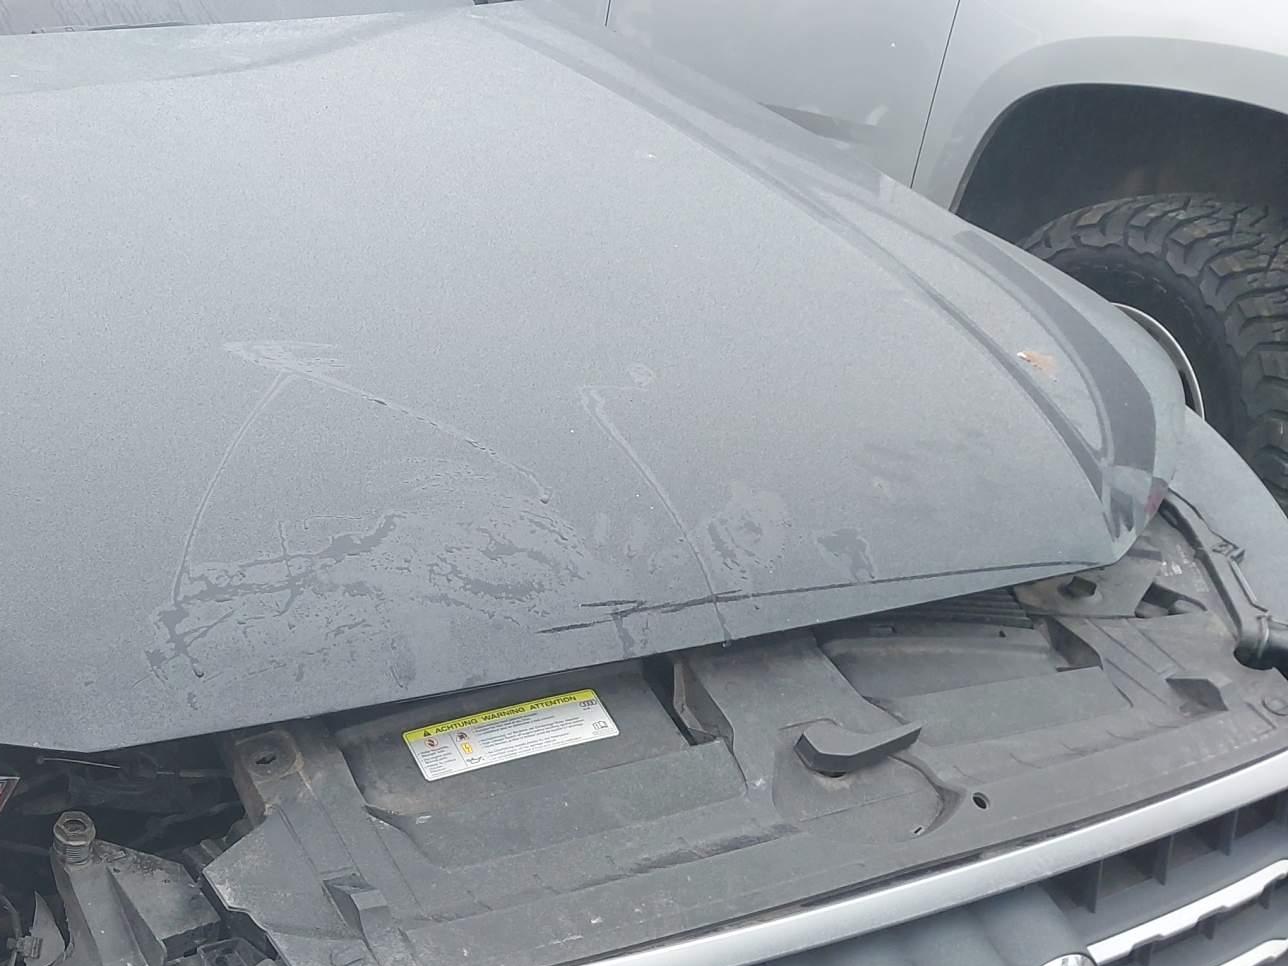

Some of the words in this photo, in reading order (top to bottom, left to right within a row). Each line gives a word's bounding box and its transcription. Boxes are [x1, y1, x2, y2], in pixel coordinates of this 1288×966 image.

[435, 719, 478, 734] ACHTUNG
[481, 706, 526, 721] WARNING
[529, 695, 577, 710] ATTENTION
